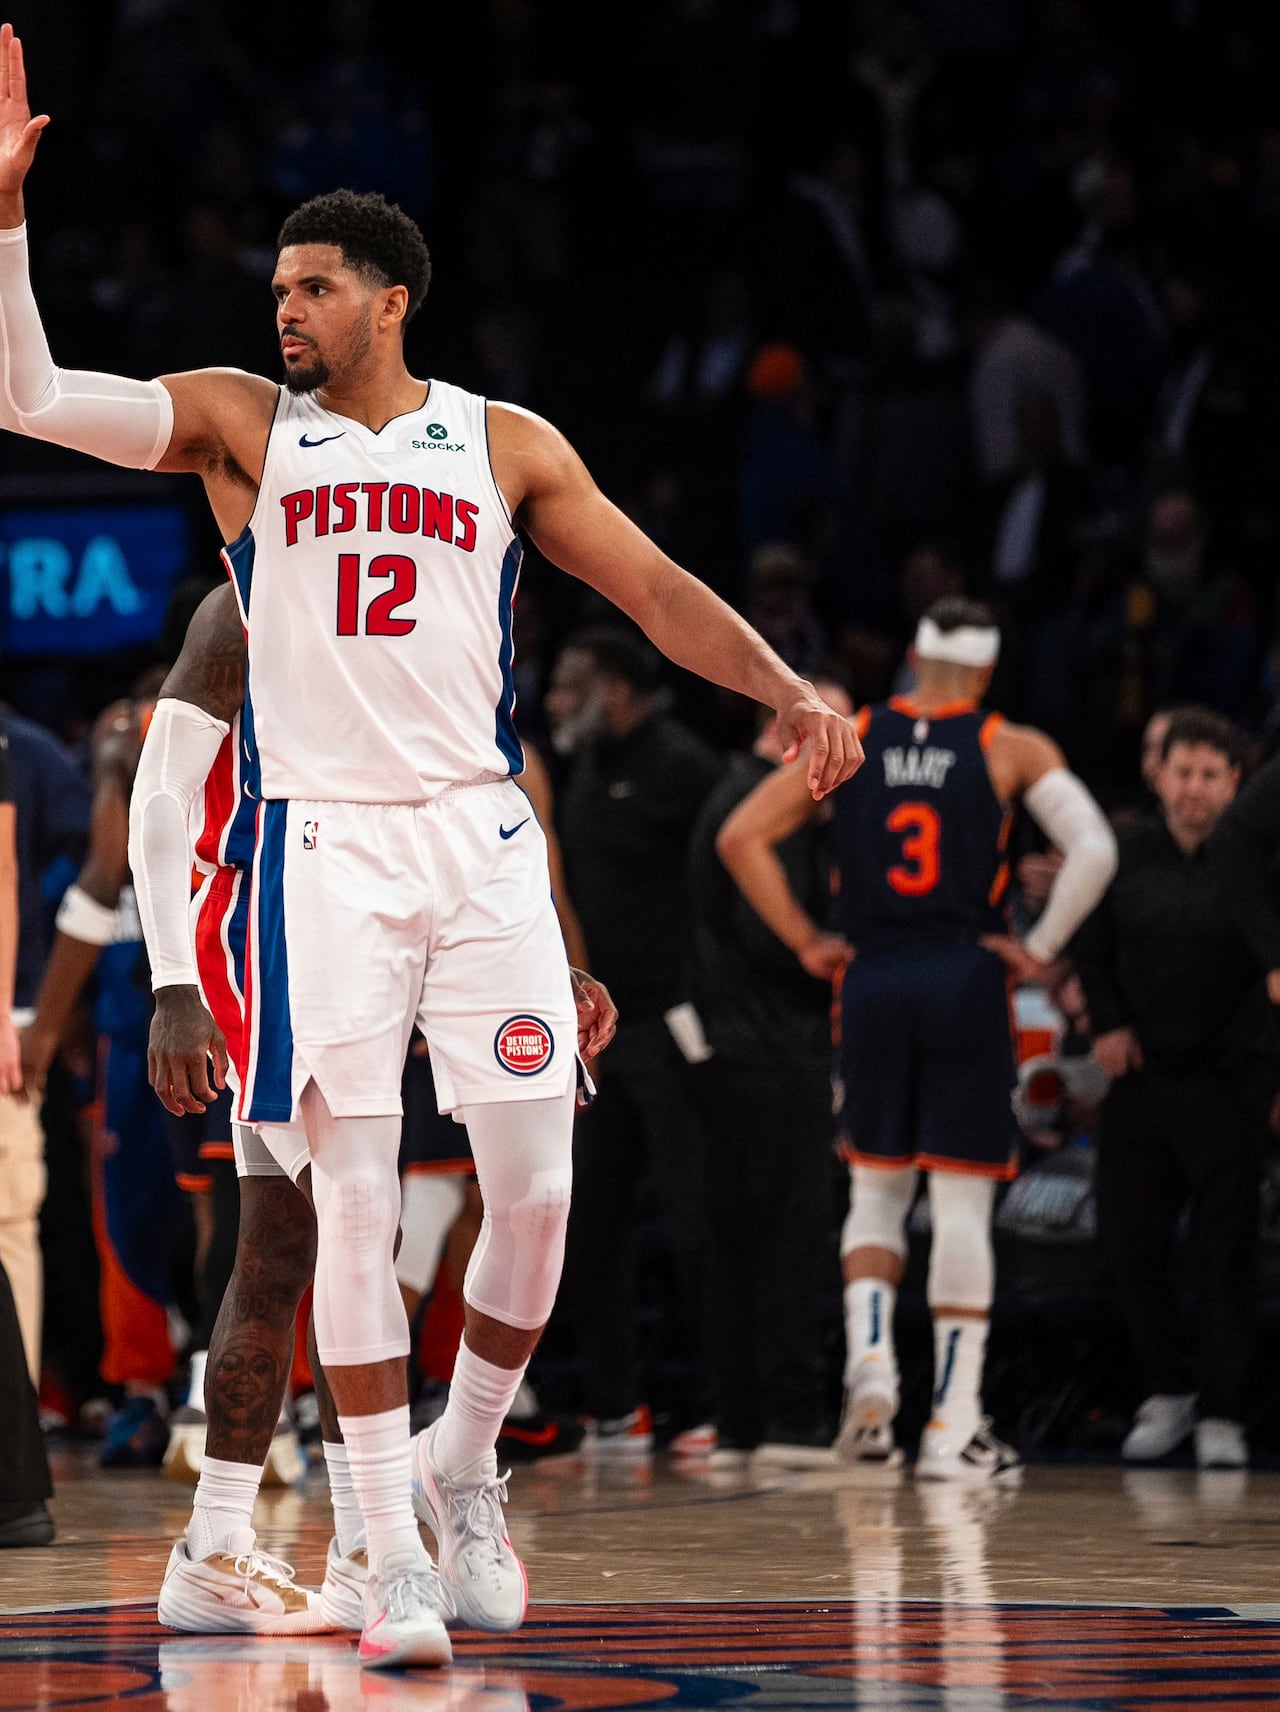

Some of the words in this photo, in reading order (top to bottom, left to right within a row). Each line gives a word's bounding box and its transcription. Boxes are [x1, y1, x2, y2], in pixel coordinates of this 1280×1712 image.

[411, 440, 466, 453] StockX
[280, 482, 480, 552] PISTONS
[336, 553, 417, 636] 12
[887, 802, 941, 897] 3
[505, 1035, 543, 1046] DETROIT
[506, 1045, 544, 1056] PISTONS
